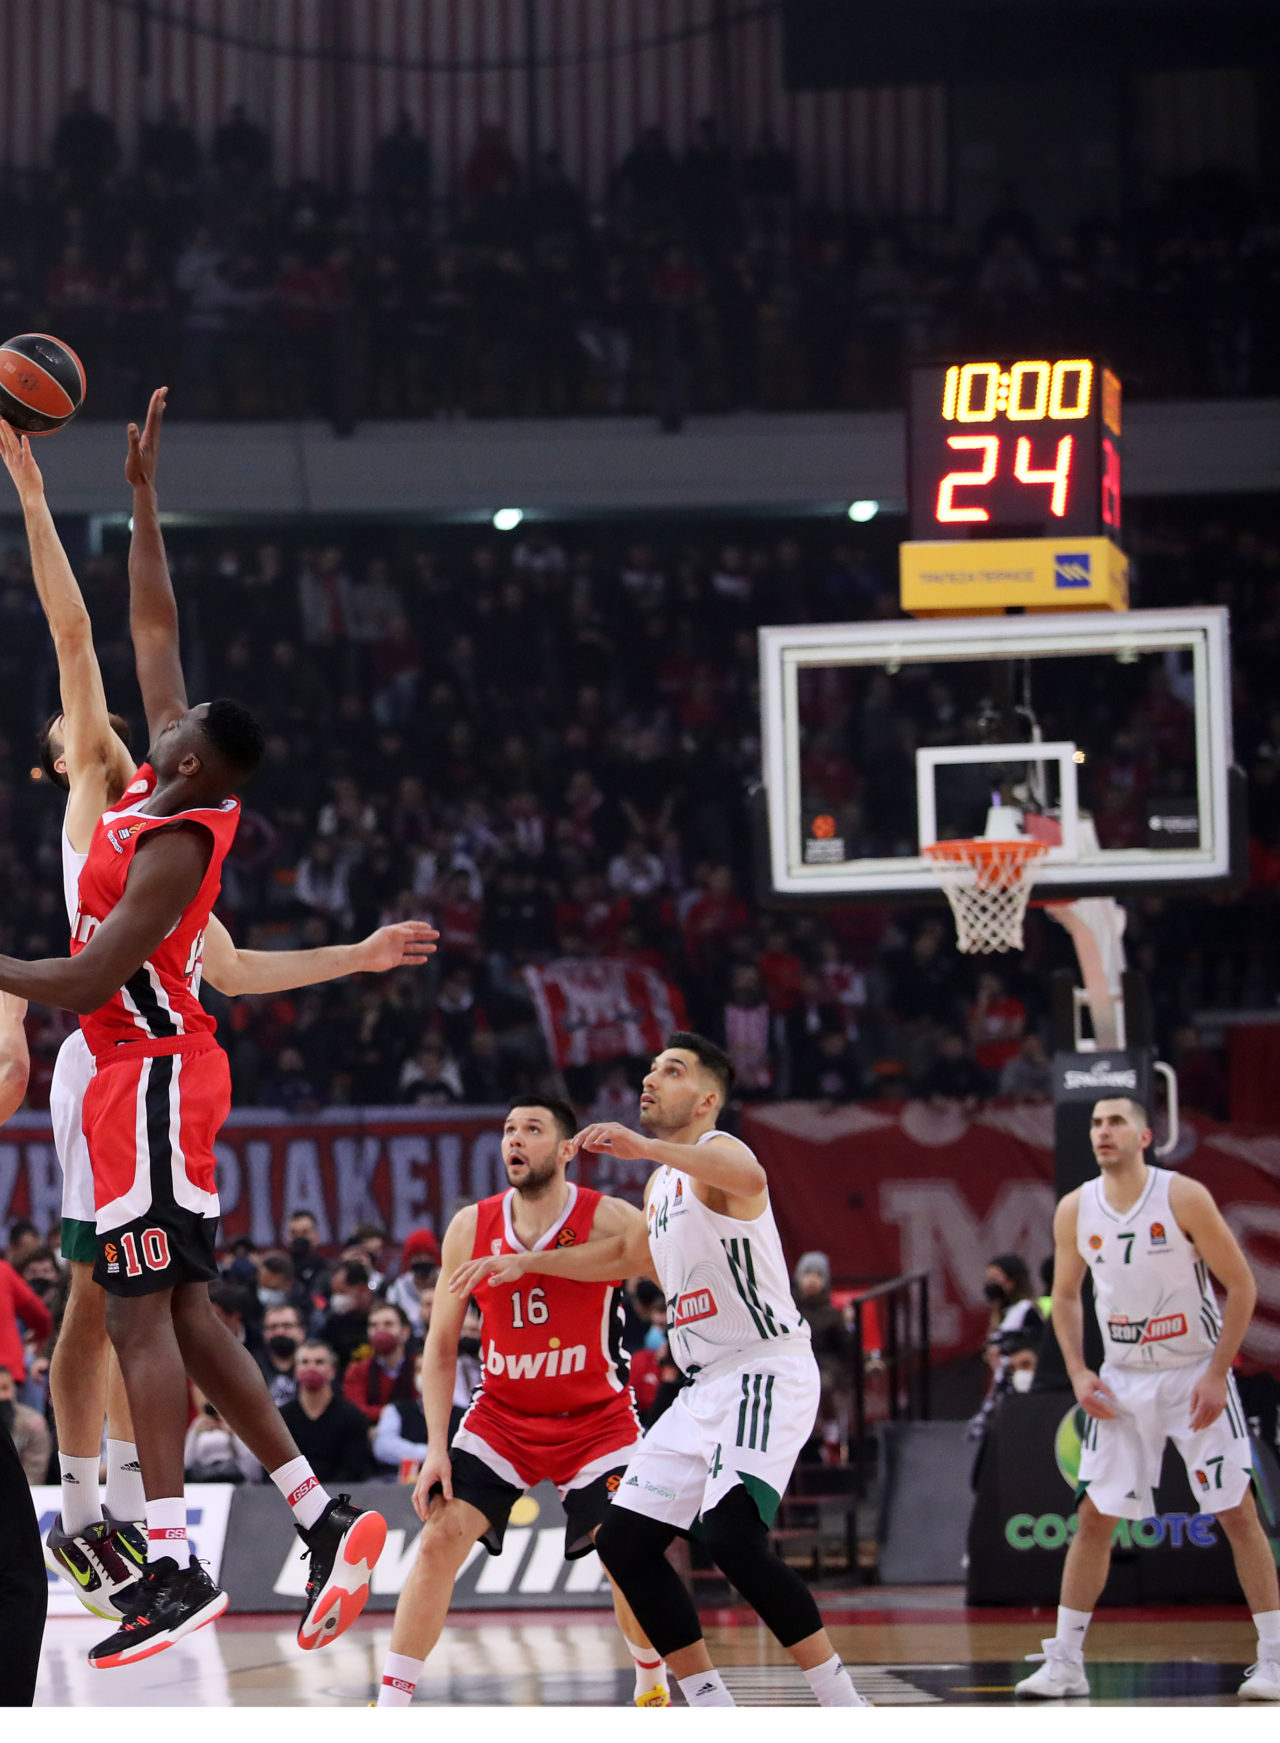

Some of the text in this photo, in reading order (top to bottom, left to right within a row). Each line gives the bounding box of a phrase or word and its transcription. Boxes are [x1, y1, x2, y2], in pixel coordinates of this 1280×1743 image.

[941, 358, 1094, 423] 10:00
[935, 434, 1074, 523] 24
[120, 1227, 172, 1278] 10
[1117, 1232, 1136, 1265] 7
[511, 1286, 550, 1329] 16
[486, 1336, 587, 1380] bwin
[1205, 1454, 1225, 1490] 7
